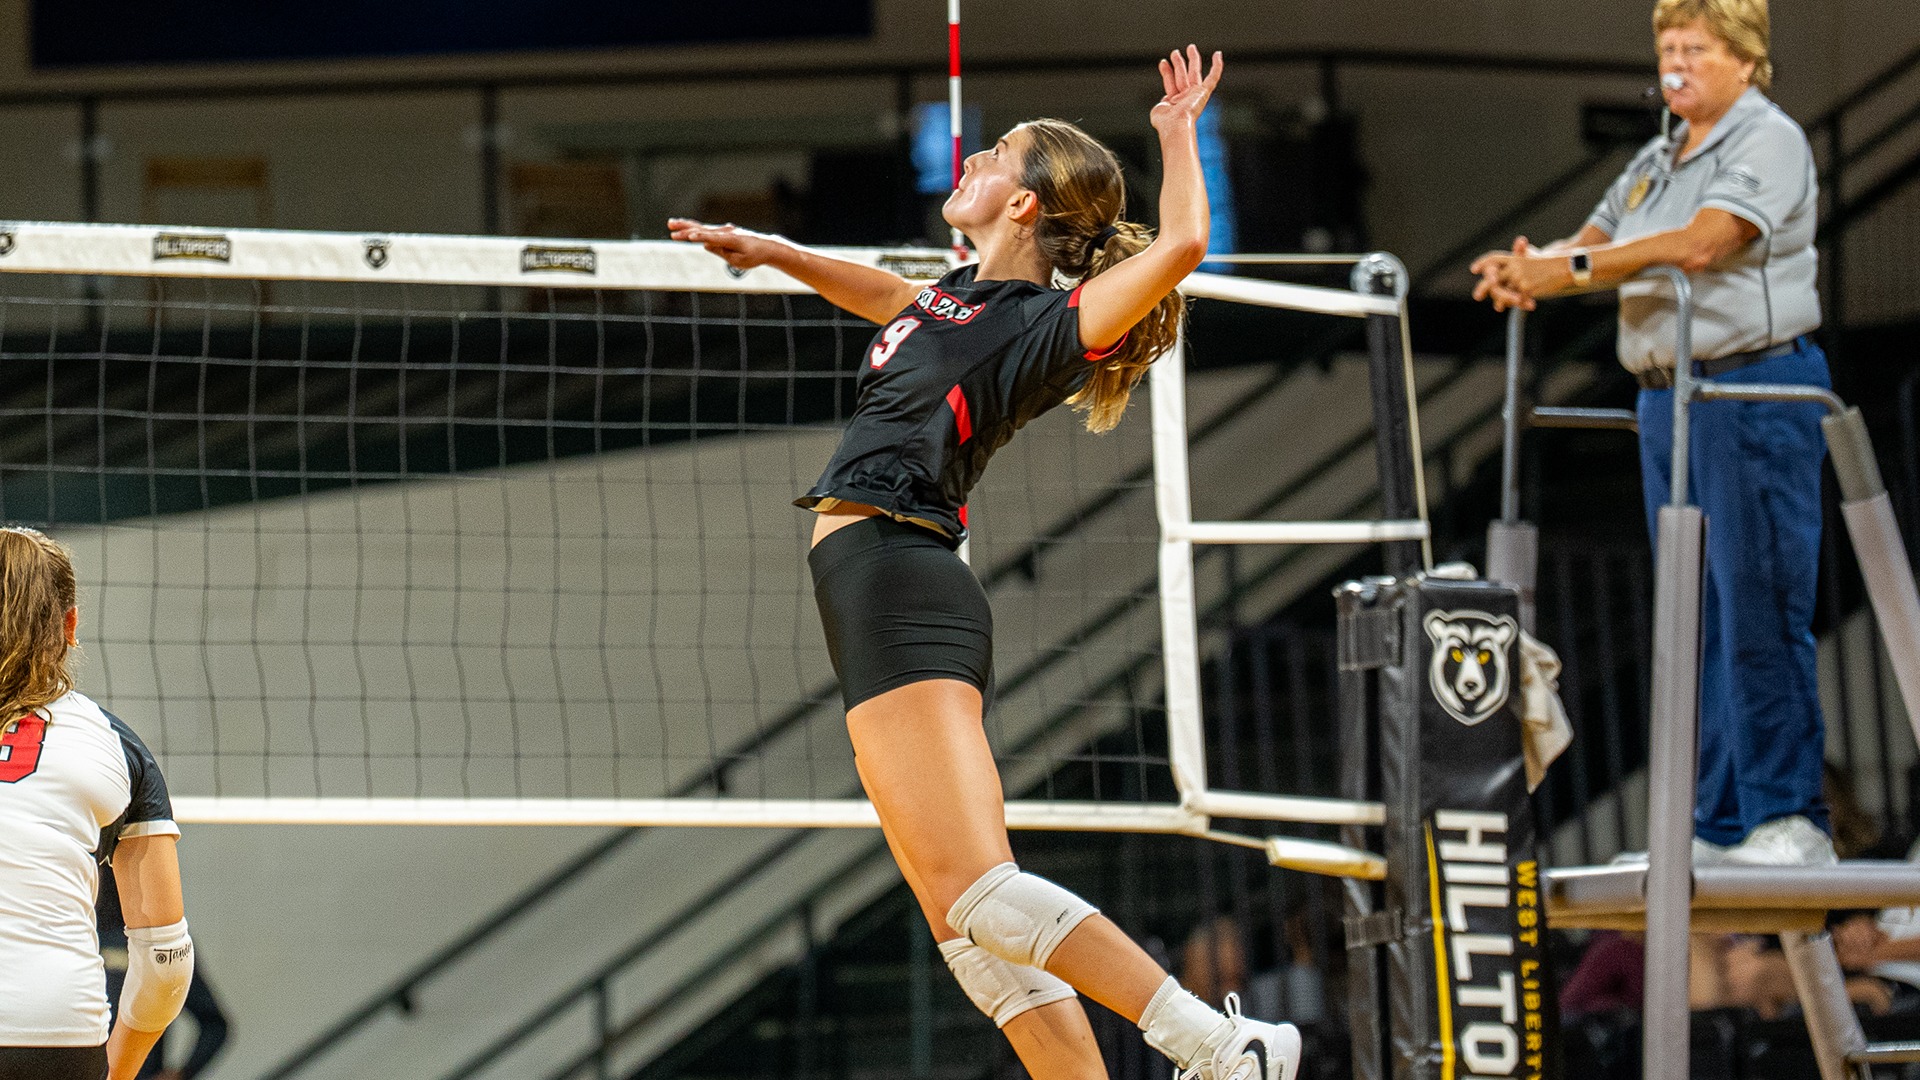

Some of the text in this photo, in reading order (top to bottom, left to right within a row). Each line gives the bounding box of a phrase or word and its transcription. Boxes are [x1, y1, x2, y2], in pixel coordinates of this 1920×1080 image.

[156, 238, 228, 258] HILLTOPPERS
[525, 252, 593, 270] HILLTOPPERS
[870, 316, 922, 370] 9
[1516, 860, 1538, 947] WEST
[1435, 809, 1519, 1080] HILLTO
